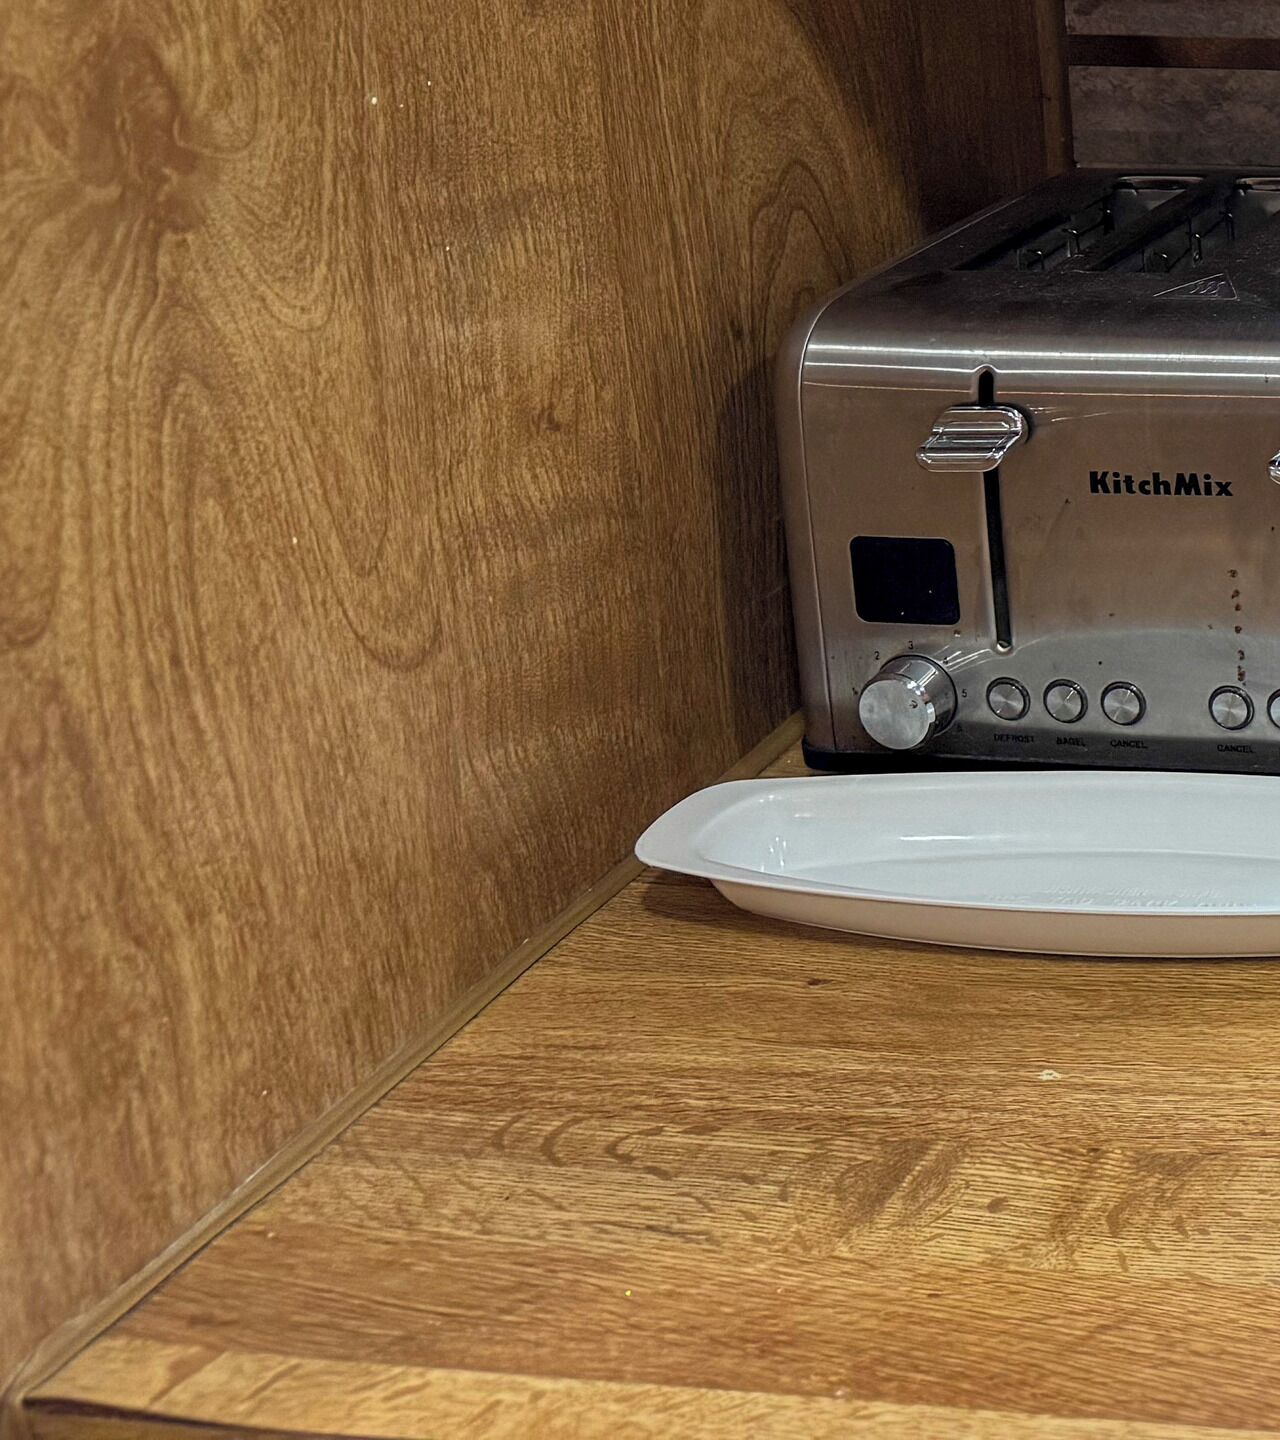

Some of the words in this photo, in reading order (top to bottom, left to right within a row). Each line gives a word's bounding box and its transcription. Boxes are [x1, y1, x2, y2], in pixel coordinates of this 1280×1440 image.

[1089, 471, 1234, 497] KitchMix
[874, 650, 880, 660] 2
[908, 641, 914, 650] 3
[961, 688, 968, 698] 5
[993, 733, 1035, 744] DEFROST
[1056, 736, 1086, 747] BAGEL
[1109, 738, 1148, 749] CANCEL
[1217, 744, 1255, 754] CANCEL
